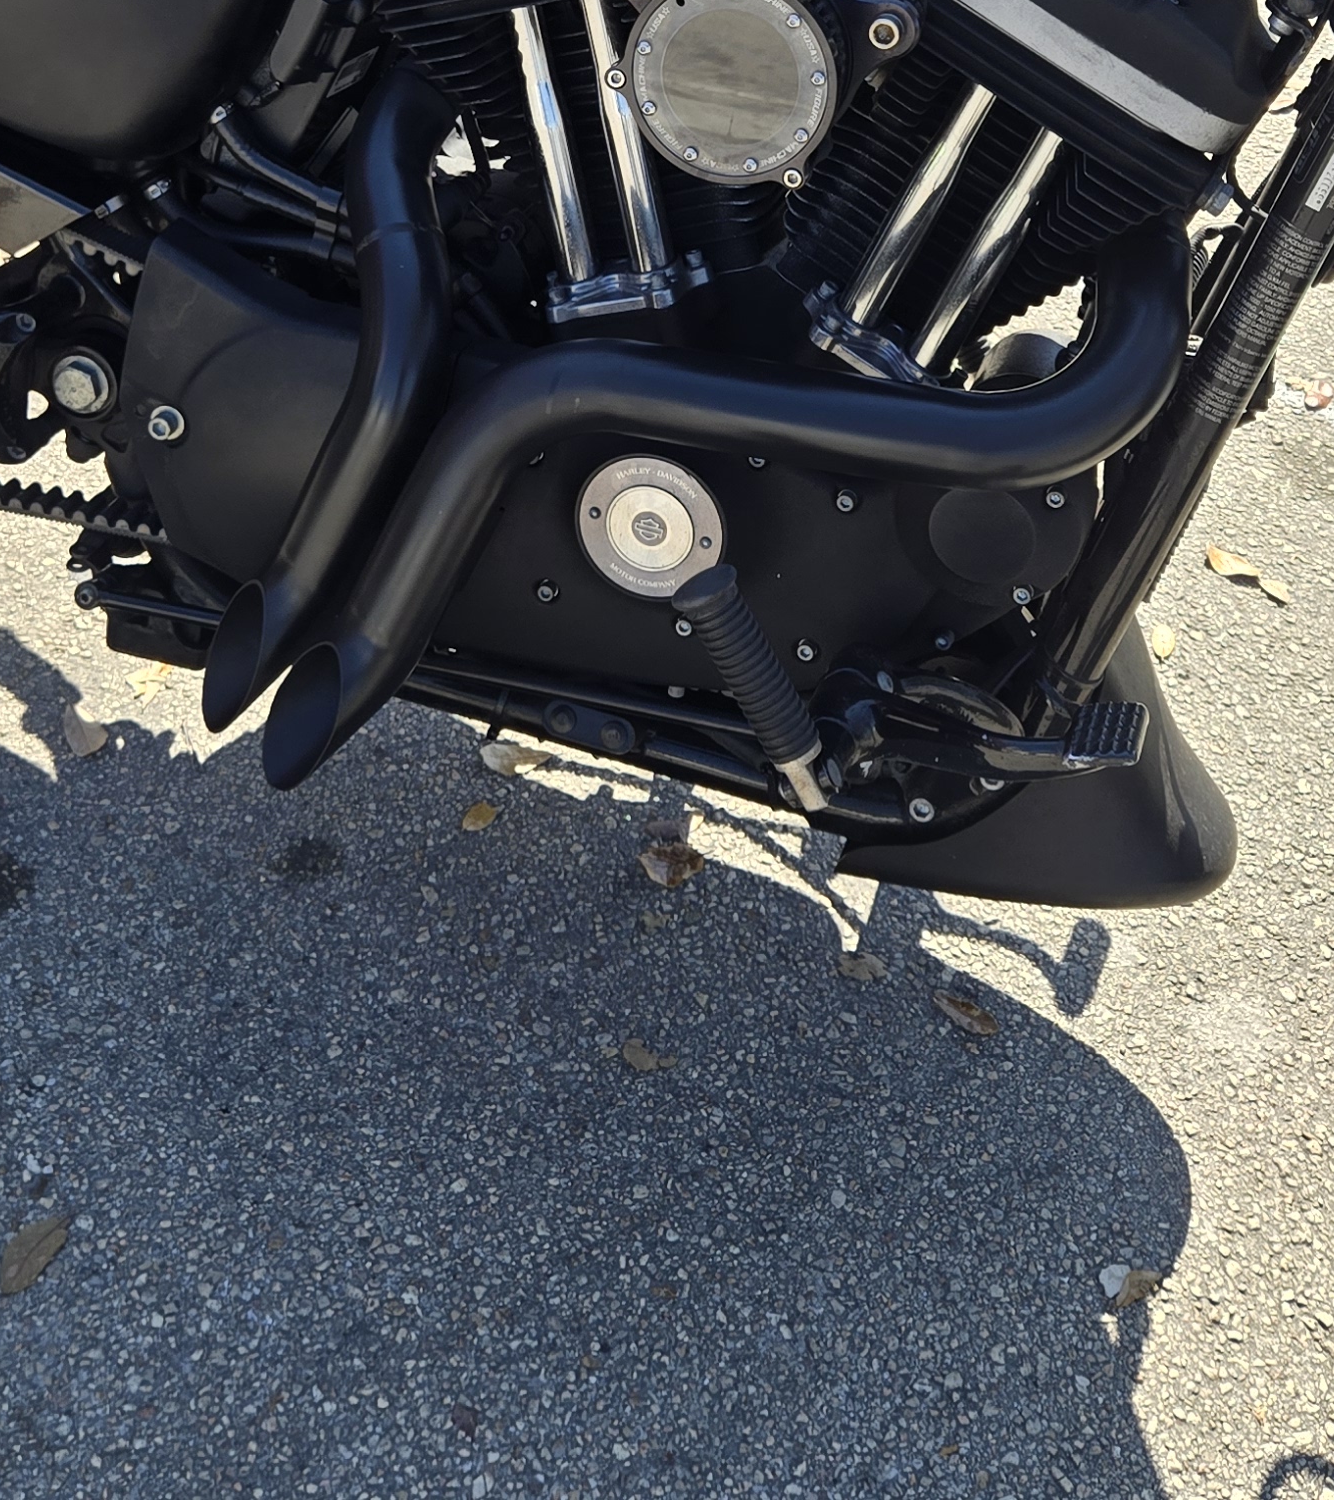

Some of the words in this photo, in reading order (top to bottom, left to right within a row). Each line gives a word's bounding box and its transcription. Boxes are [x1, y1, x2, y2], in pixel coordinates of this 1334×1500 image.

[806, 88, 823, 128] FIGURE
[616, 467, 652, 480] HARLEY
[656, 469, 697, 499] DAVIDSON
[609, 562, 636, 583] MOTOR
[637, 578, 676, 588] COMPANY
